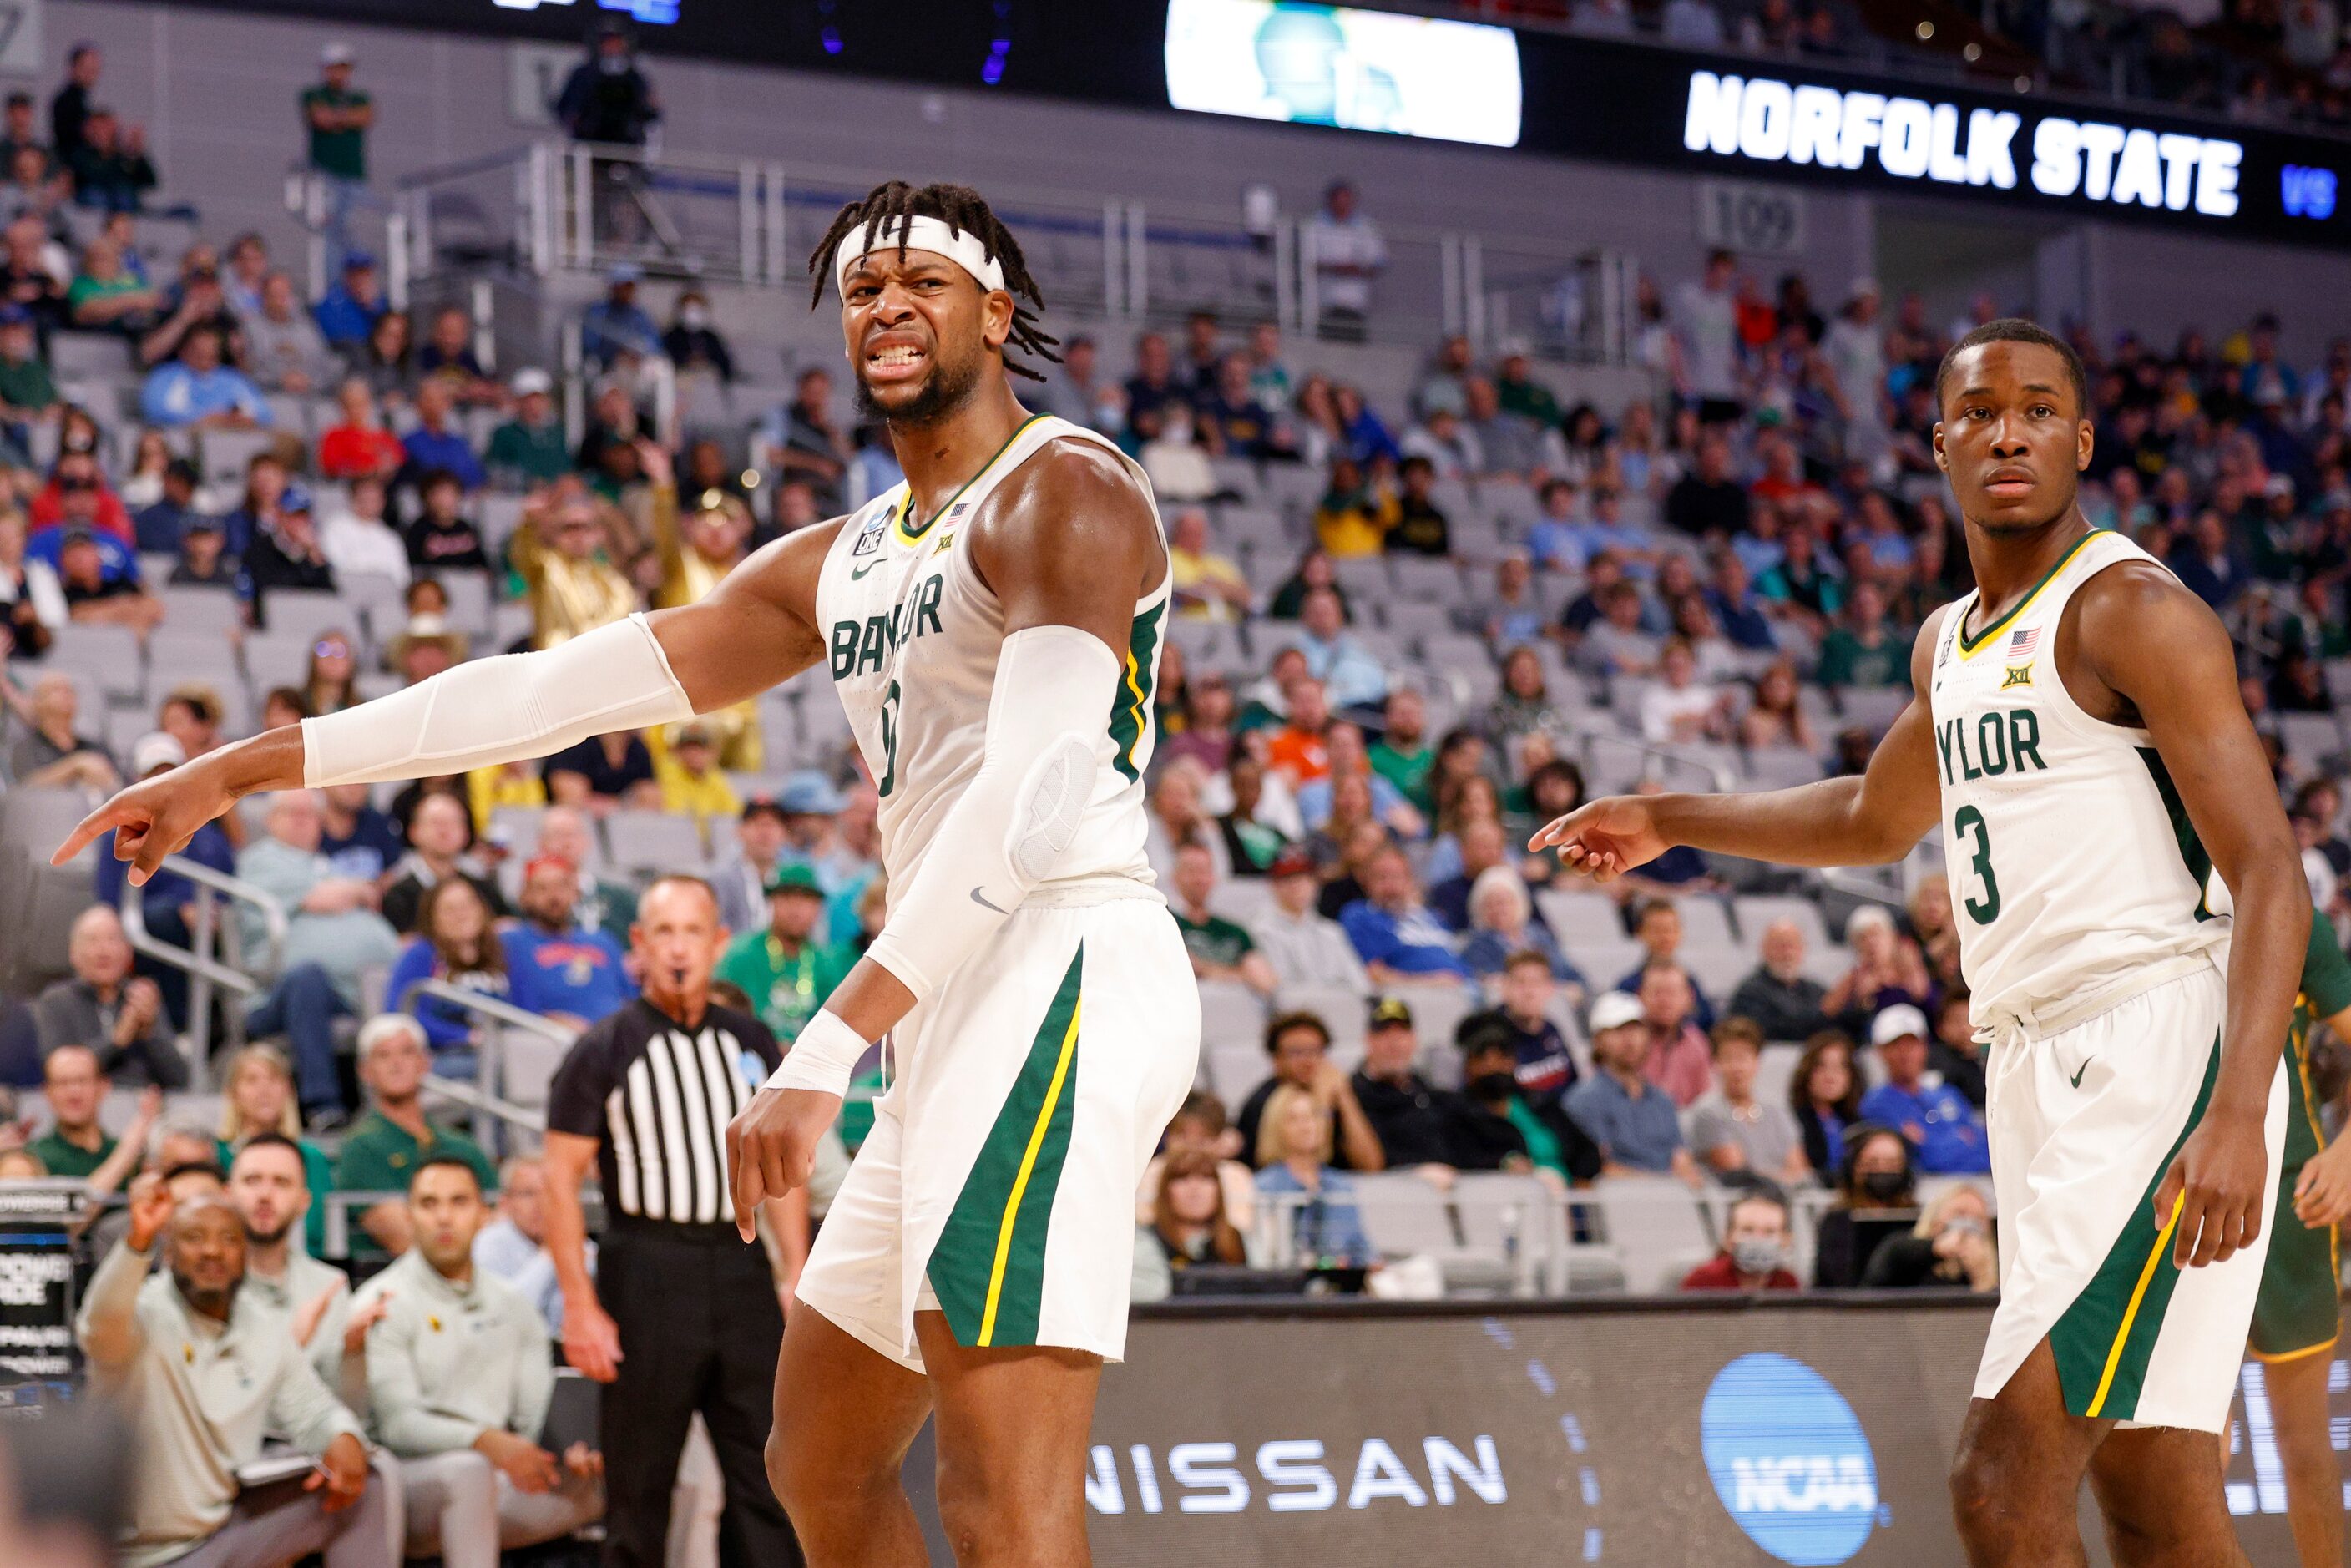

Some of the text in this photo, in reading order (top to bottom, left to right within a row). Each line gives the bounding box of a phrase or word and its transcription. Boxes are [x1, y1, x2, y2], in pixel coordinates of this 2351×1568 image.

[1684, 69, 2021, 190] NORFOLK
[2031, 117, 2243, 217] STATE
[1716, 192, 1795, 249] 109
[858, 529, 883, 550] ONE
[832, 574, 943, 681] BAYOR
[1954, 805, 2000, 925] 3
[1731, 1455, 1878, 1513] NCAA
